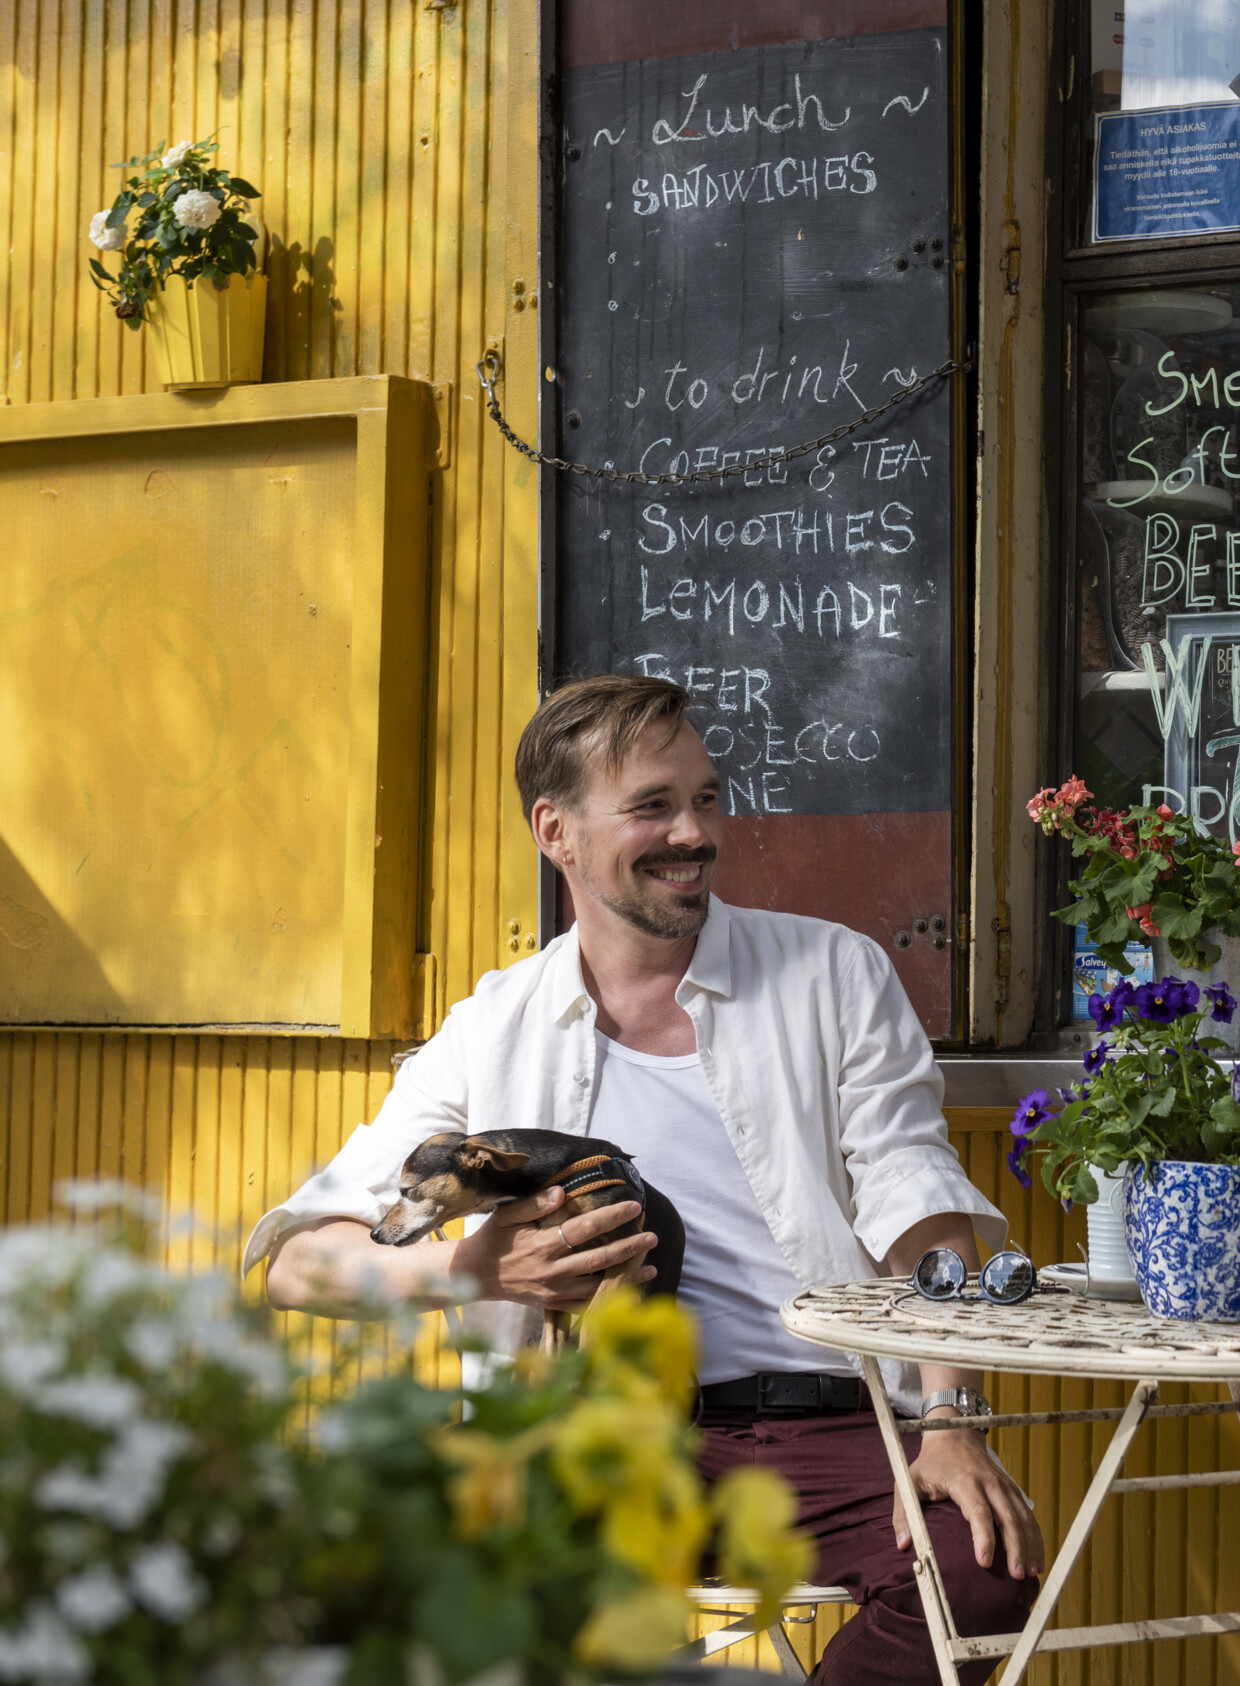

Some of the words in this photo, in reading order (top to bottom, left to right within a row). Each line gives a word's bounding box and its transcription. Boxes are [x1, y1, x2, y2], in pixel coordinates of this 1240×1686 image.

[652, 73, 851, 146] Lunch
[1141, 124, 1164, 137] HYVÄ
[1167, 121, 1207, 134] ASIAKAS
[1103, 163, 1117, 171] saa
[1118, 159, 1159, 171] anniskella
[1160, 157, 1177, 167] eikä
[1110, 150, 1151, 160] Tiedäthän,
[1153, 147, 1168, 156] että
[1170, 141, 1227, 154] alkoholijuomia
[1229, 140, 1237, 149] ei
[1124, 170, 1151, 182] myydä
[1153, 169, 1167, 178] alle
[1169, 164, 1220, 177] 18-vuotiaalle.
[632, 151, 877, 216] SANDWICHES
[664, 361, 709, 412] to
[731, 339, 869, 413] drink
[639, 437, 789, 488] COFFEE
[853, 437, 932, 480] TEA
[637, 501, 917, 556] SMOOTHIES
[703, 721, 881, 770] OSECCO
[728, 771, 794, 817] NE
